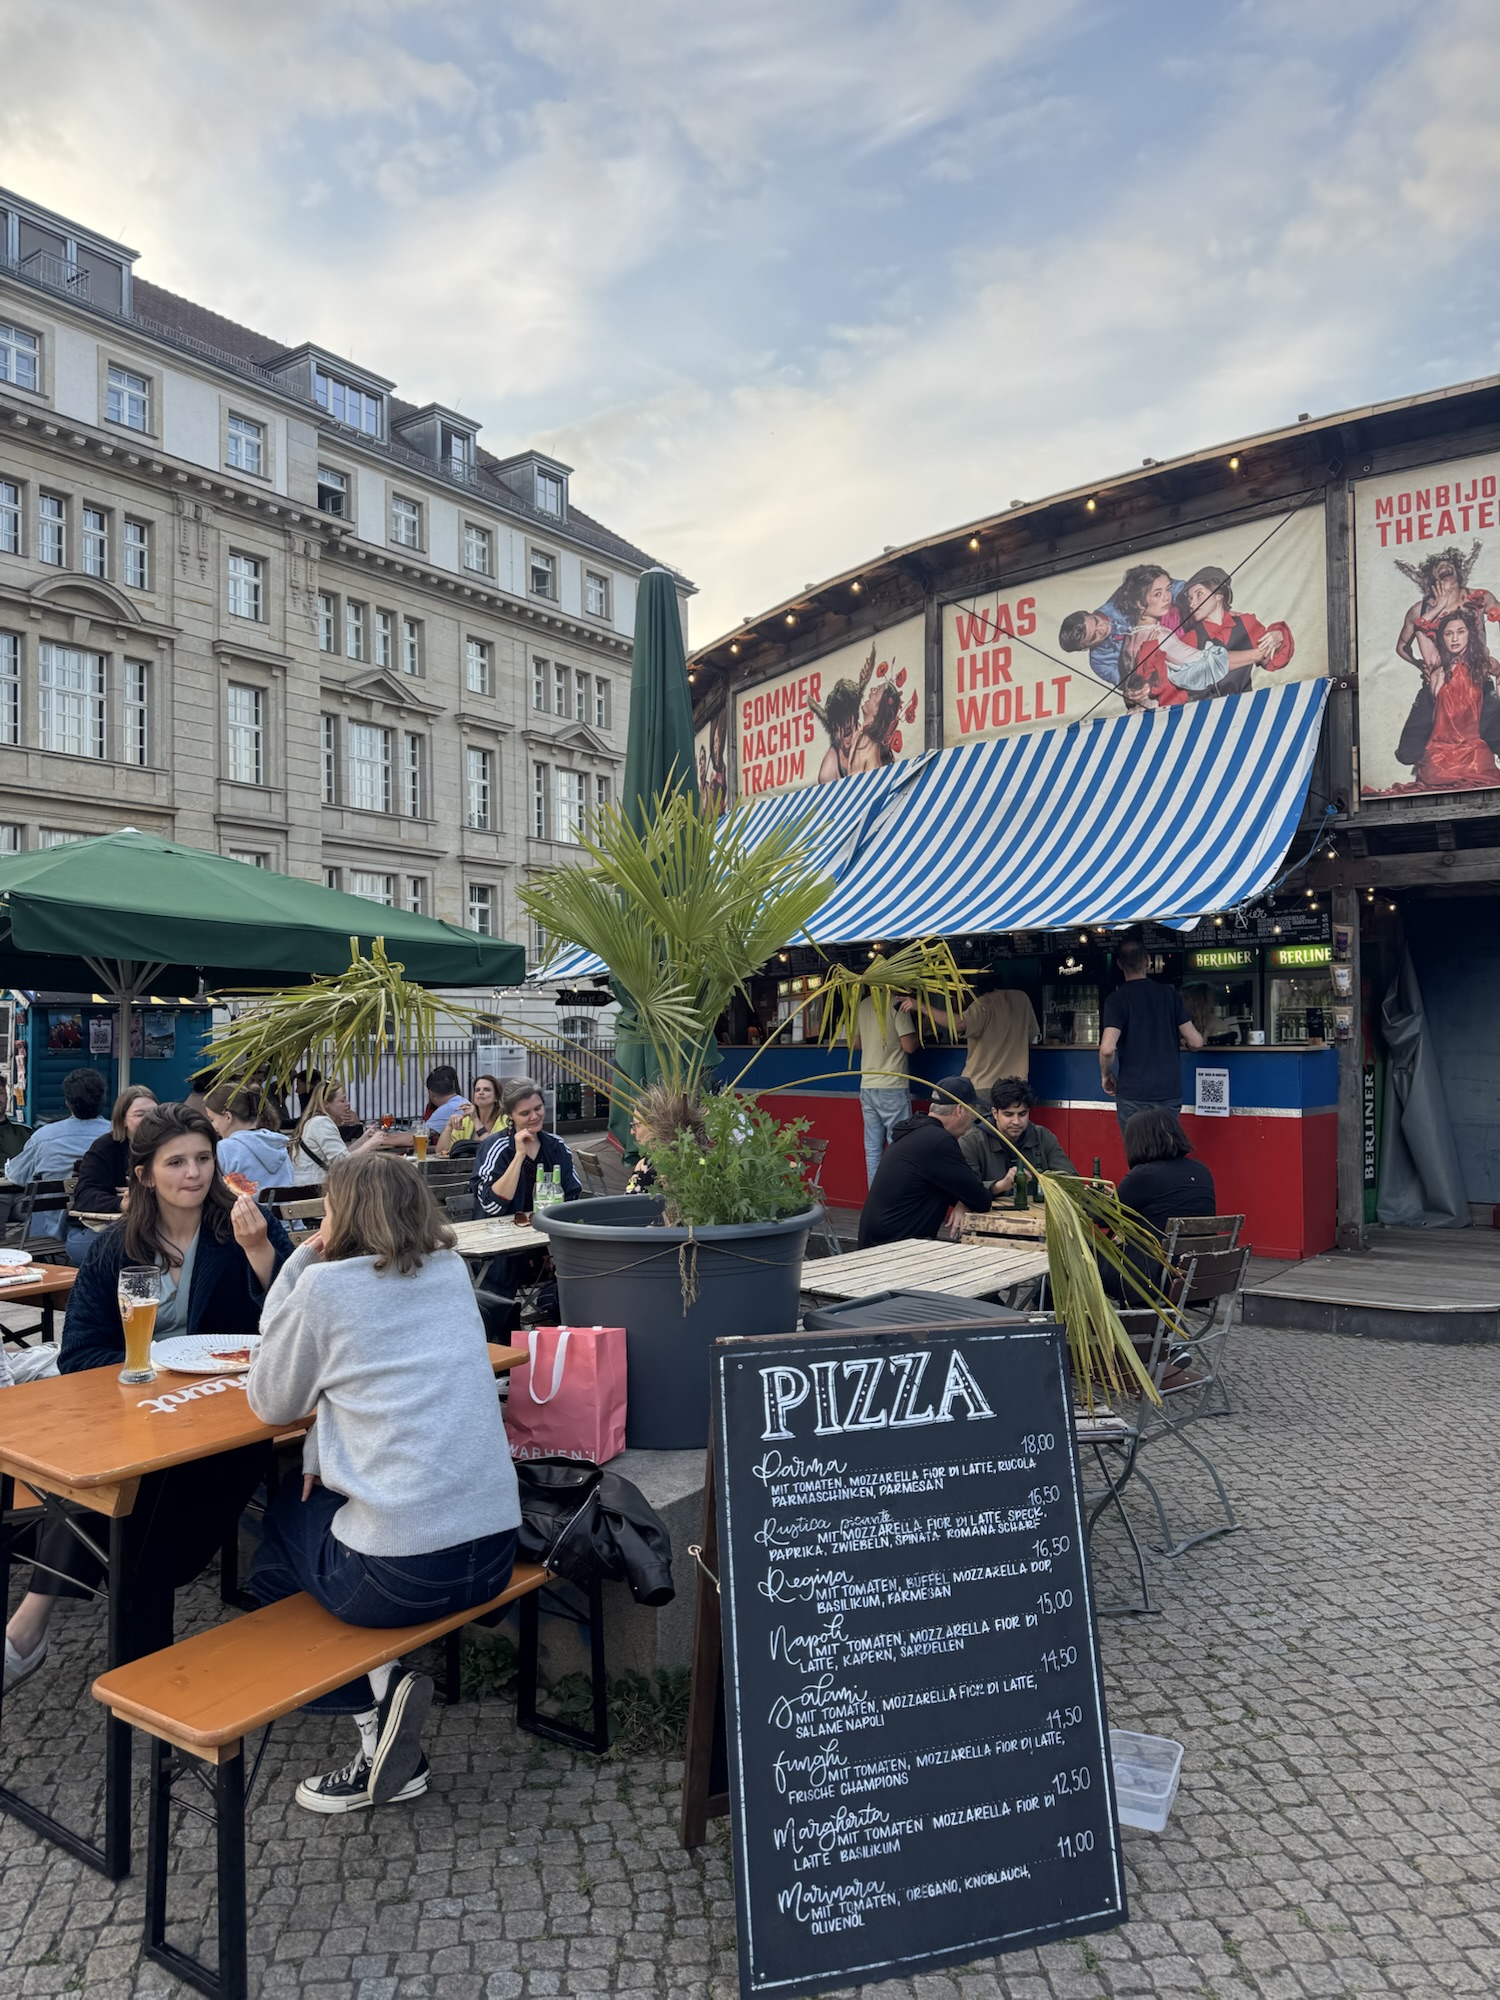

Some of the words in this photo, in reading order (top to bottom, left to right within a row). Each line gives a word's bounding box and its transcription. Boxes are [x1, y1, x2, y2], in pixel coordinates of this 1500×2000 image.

[1376, 475, 1496, 520] MONBIJO
[1376, 499, 1500, 547] THEATE
[955, 597, 1037, 651] WAS
[956, 646, 1013, 694] IHR
[742, 672, 822, 731] SOMMER
[956, 675, 1072, 734] WOLLT
[742, 711, 815, 763] NACHTS
[742, 750, 805, 797] TRAUM
[1196, 950, 1252, 967] BERLINER
[1279, 947, 1332, 965] BERLINE
[1365, 1072, 1375, 1180] BERLINER
[758, 1349, 997, 1442] PIZZA
[752, 1450, 848, 1487] Parma
[1021, 1433, 1055, 1455] 18,00
[771, 1483, 790, 1496] MIT
[850, 1469, 919, 1487] MOZZARELLA
[923, 1467, 946, 1480] FIOR
[949, 1465, 960, 1477] DI
[962, 1461, 997, 1476] LATTE,
[998, 1457, 1037, 1472] RUCOLA
[754, 1517, 831, 1547] Rustica
[840, 1509, 893, 1534] picante
[1028, 1485, 1060, 1506] 16,50
[772, 1487, 876, 1507] PARMASCHINKEN,
[879, 1478, 944, 1496] PARMESAN
[817, 1531, 840, 1545] MIT
[843, 1520, 923, 1541] MOZZARELLA
[927, 1517, 951, 1531] FIOR
[956, 1515, 968, 1528] DI
[831, 1537, 893, 1554] ZWIEBELN,
[895, 1531, 940, 1546] SPINATA
[947, 1524, 996, 1539] ROMANA
[998, 1518, 1041, 1534] SCHARF
[758, 1566, 854, 1603] Regina
[1032, 1535, 1070, 1557] 16,50
[816, 1587, 839, 1601] MIT
[841, 1578, 901, 1596] TOMATEN,
[953, 1563, 1027, 1583] MOZZARELLA
[1031, 1559, 1052, 1574] DOP,
[770, 1614, 850, 1665] Napoli
[1036, 1589, 1073, 1615] 15,00
[817, 1597, 885, 1614] BASILIKUM,
[800, 1657, 838, 1674] LATTE,
[843, 1649, 897, 1667] KAPERN,
[900, 1638, 964, 1658] SARDELLEN
[816, 1643, 840, 1657] MIT
[846, 1633, 906, 1652] TOMATEN,
[910, 1621, 990, 1644] MOZZARELLA
[995, 1618, 1020, 1632] FIOR
[1026, 1614, 1038, 1627] DI
[768, 1672, 867, 1730] Salami
[1041, 1646, 1077, 1673] 14,50
[795, 1709, 816, 1724] MIT
[883, 1688, 957, 1711] MOZZARELLA
[987, 1682, 999, 1695] DI
[1003, 1675, 1038, 1692] LATTE,
[796, 1720, 843, 1739] SALAME
[846, 1714, 885, 1731] NAPOLI
[1046, 1705, 1083, 1730] 14,50
[828, 1767, 850, 1782] MIT
[853, 1758, 911, 1779] TOMATEN,
[916, 1744, 991, 1768] MOZZARELLA
[996, 1738, 1018, 1754] FIOR
[1020, 1736, 1032, 1749] DI
[1034, 1731, 1065, 1748] LATTE,
[773, 1802, 889, 1854] Margherita
[1052, 1766, 1091, 1795] 12,50
[788, 1785, 835, 1805] FRISCHE
[840, 1772, 909, 1796] CHAMPIONS
[837, 1830, 860, 1846] MIT
[864, 1818, 923, 1841] TOMATEN
[933, 1801, 1011, 1829] MOZZARELLA
[1016, 1796, 1040, 1814] FIOR
[1044, 1794, 1055, 1808] DI
[778, 1878, 886, 1922] Marinara
[1057, 1830, 1094, 1858] 11,00
[793, 1852, 831, 1871] LATTE
[840, 1839, 901, 1863] BASILIKUM
[811, 1903, 834, 1920] MIT
[838, 1892, 900, 1914] TOMATEN,
[906, 1879, 961, 1901] OREGANO,
[964, 1864, 1031, 1891] KNOBLAUCH,
[811, 1911, 865, 1935] OLIVENÖL
